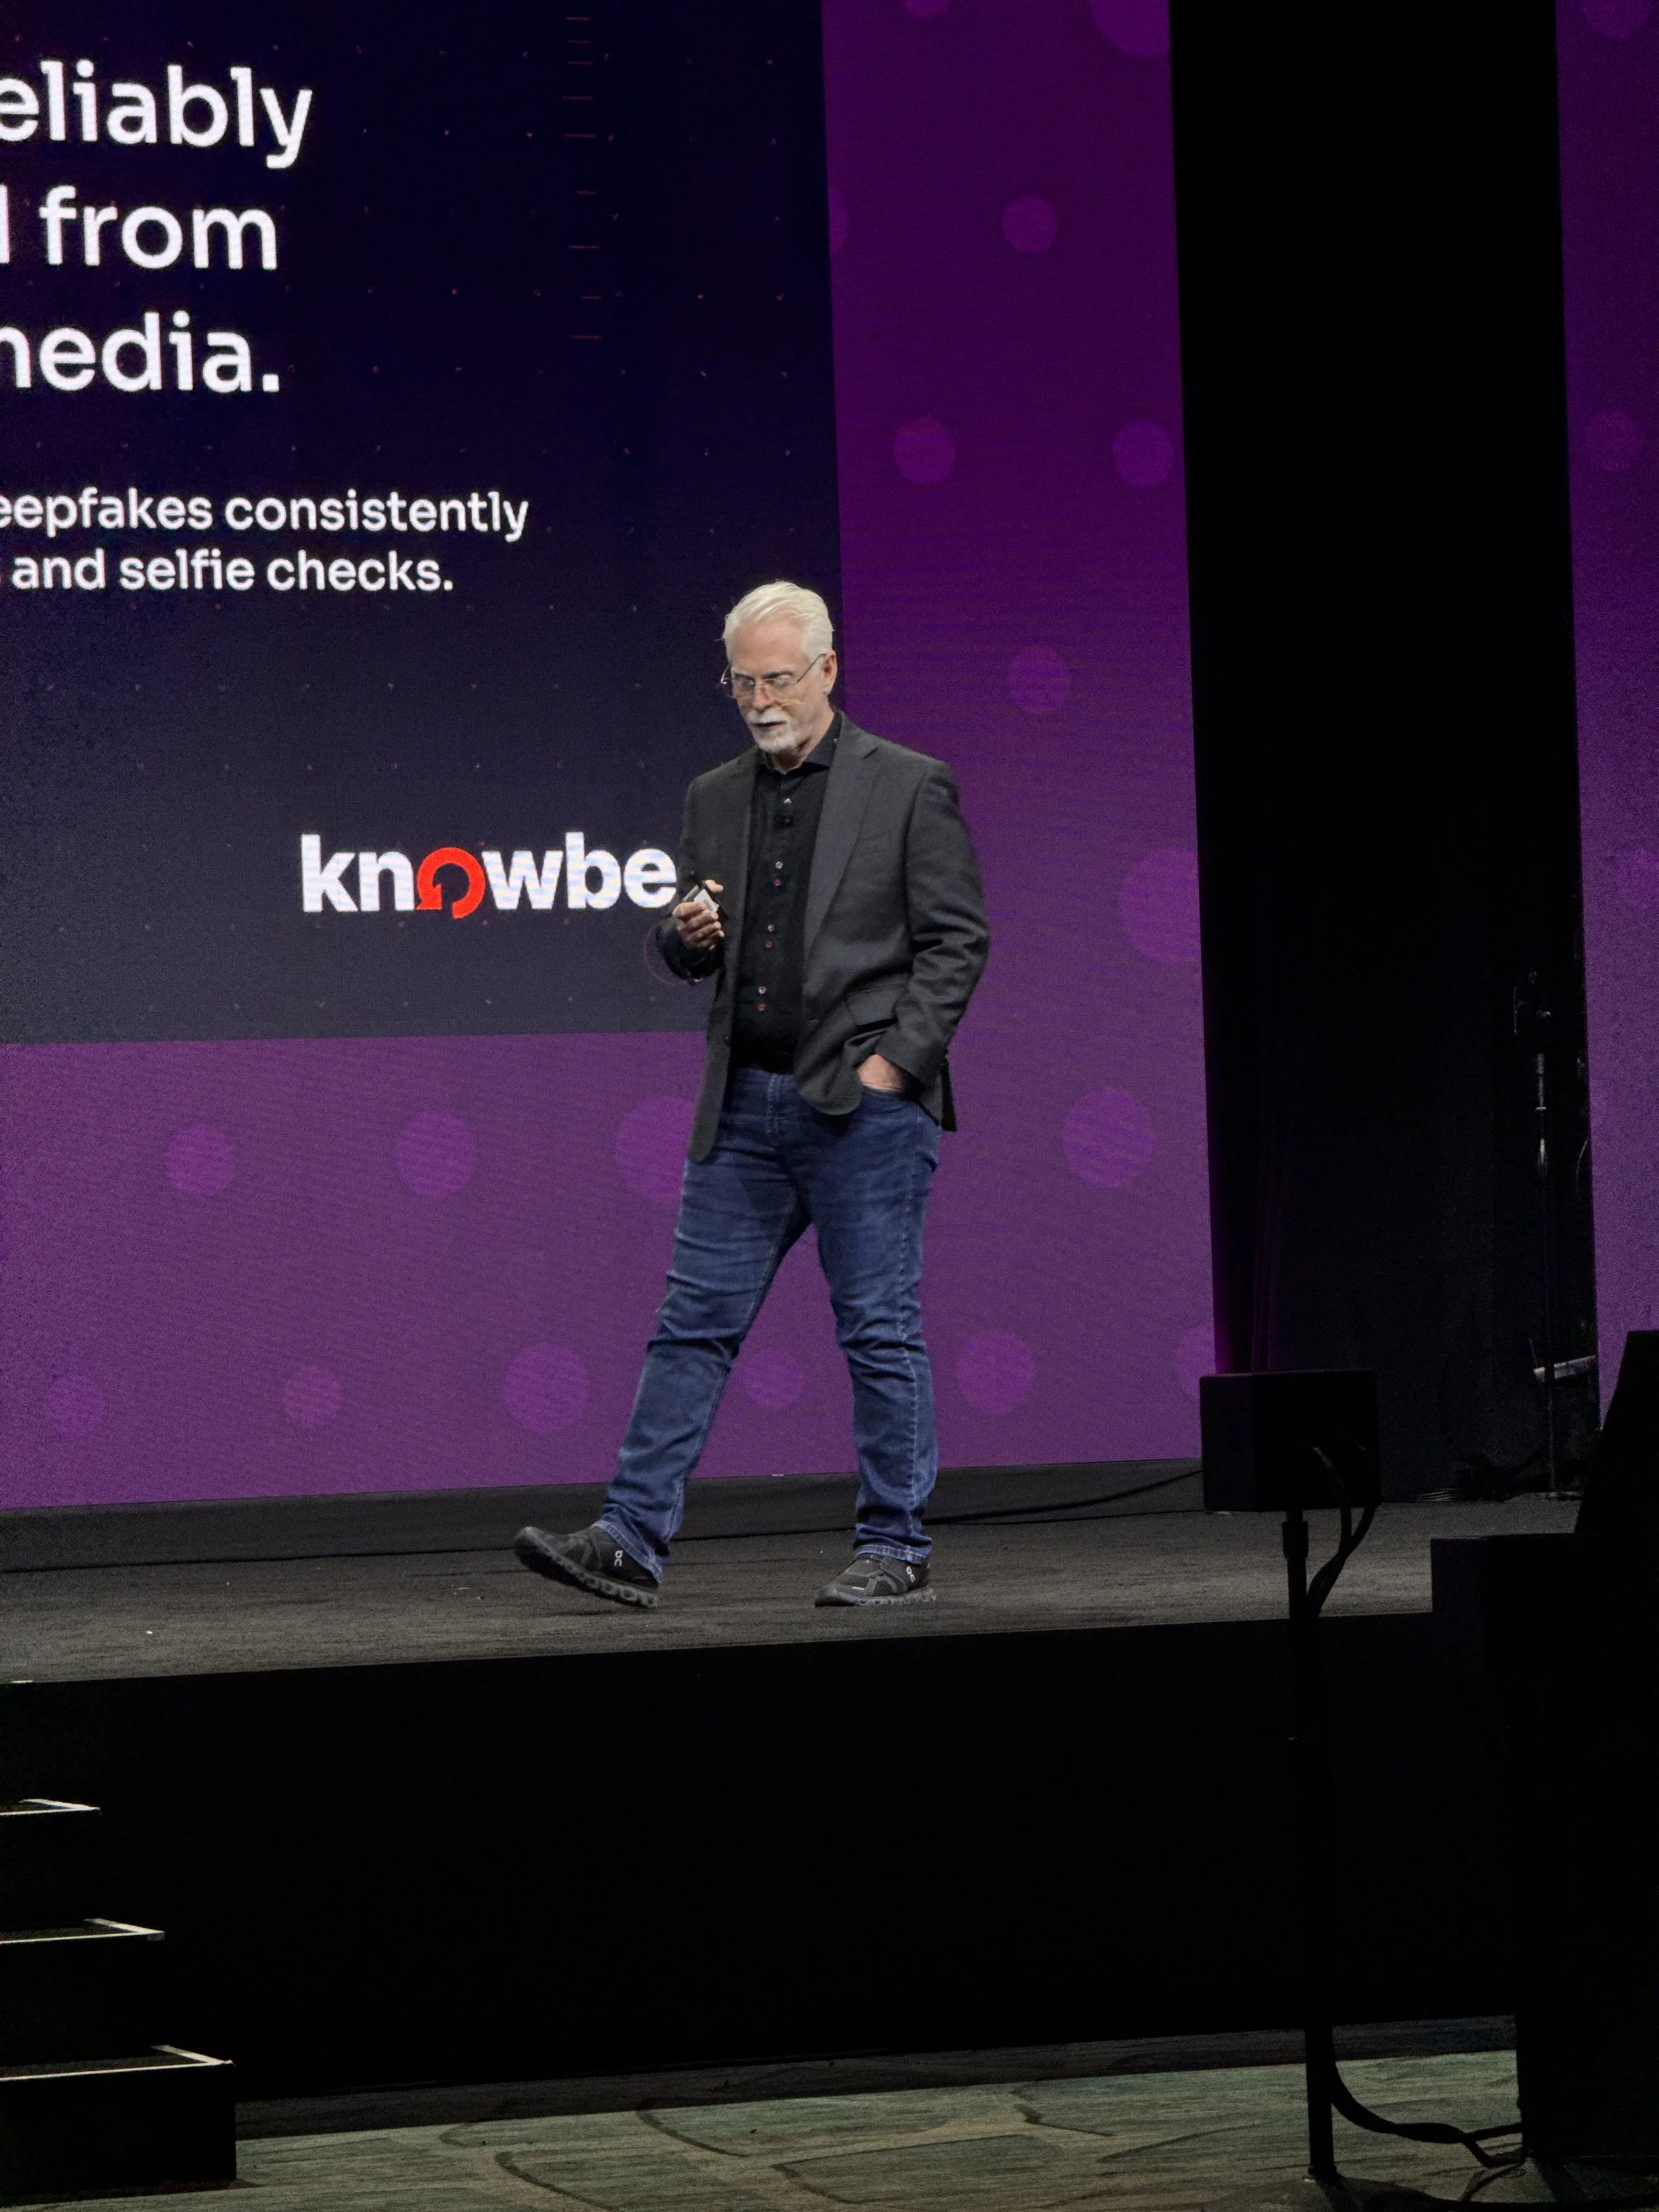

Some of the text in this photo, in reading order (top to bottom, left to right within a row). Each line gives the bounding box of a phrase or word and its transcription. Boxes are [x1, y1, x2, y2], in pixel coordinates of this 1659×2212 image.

[38, 184, 278, 270] from
[224, 488, 530, 543] consistently
[11, 547, 454, 592] and selfie checks.
